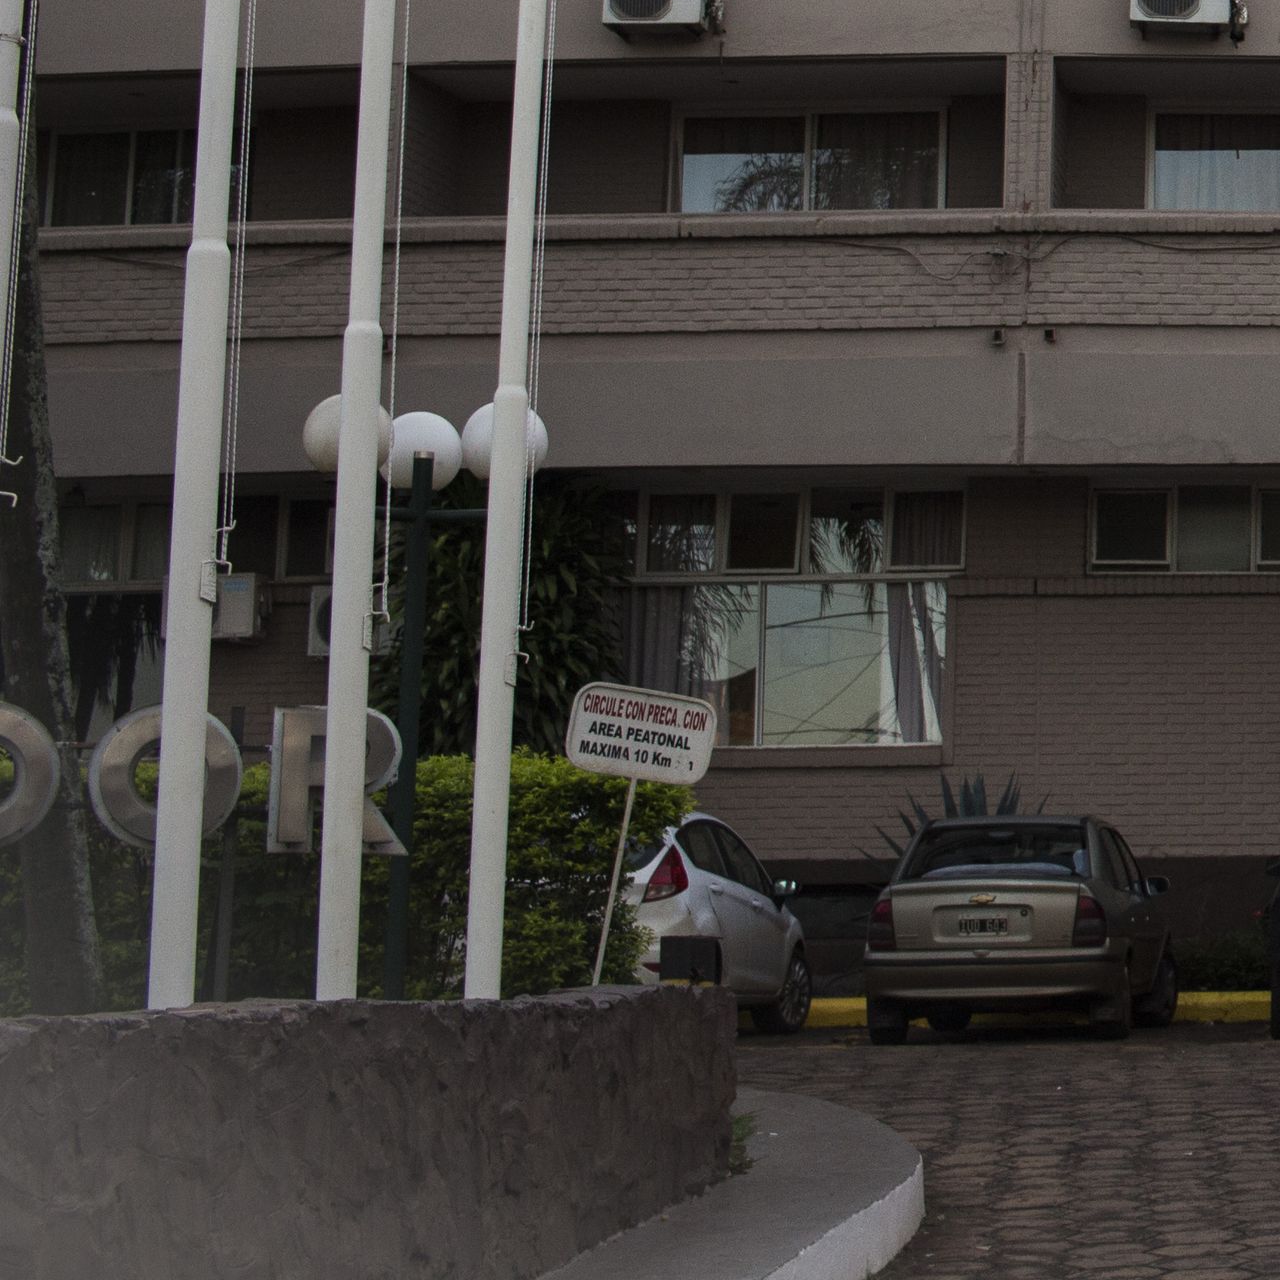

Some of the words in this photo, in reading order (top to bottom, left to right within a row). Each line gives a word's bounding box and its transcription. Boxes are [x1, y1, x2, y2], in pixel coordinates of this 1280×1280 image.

[584, 693, 625, 717] CIRCULE
[626, 700, 647, 721] CON
[589, 721, 622, 739] AREA
[626, 727, 691, 750] PEATONAL
[579, 740, 630, 761] MAXIMA
[634, 749, 649, 763] 10
[652, 752, 672, 767] Km
